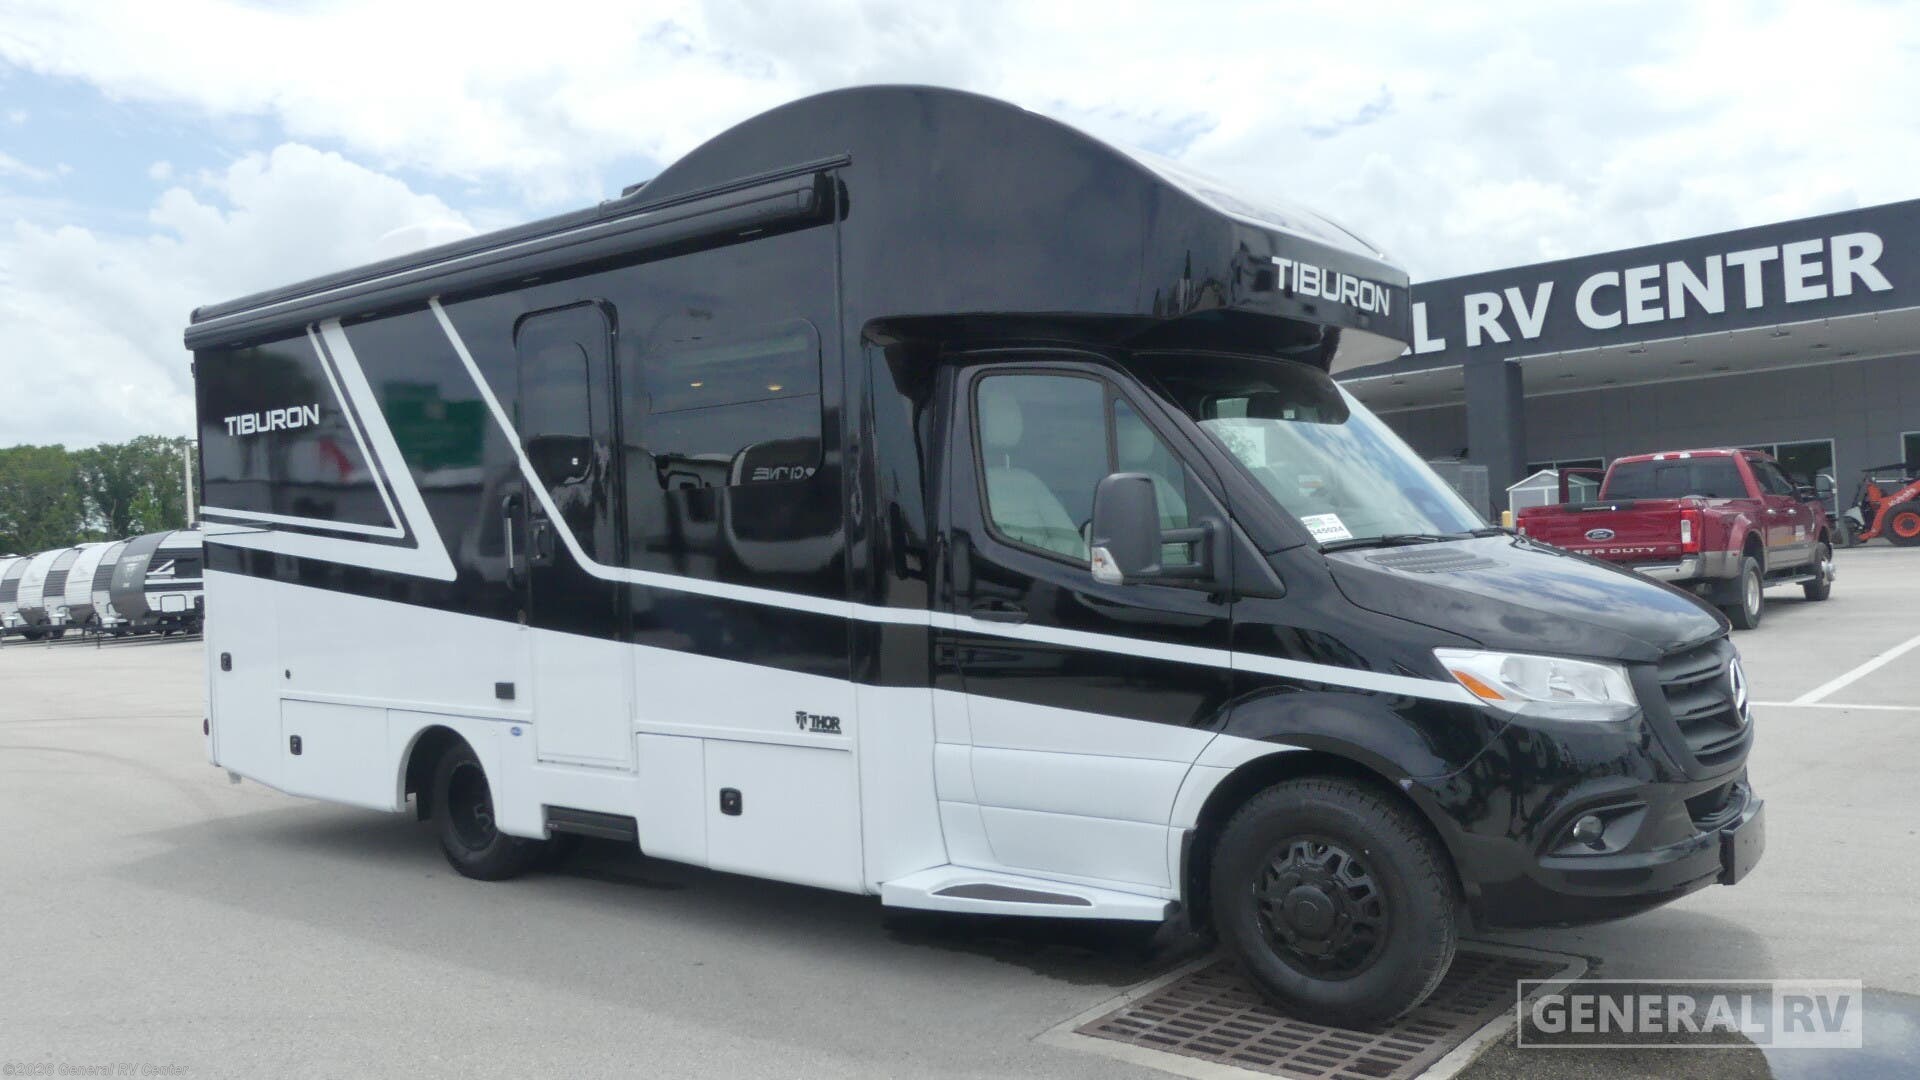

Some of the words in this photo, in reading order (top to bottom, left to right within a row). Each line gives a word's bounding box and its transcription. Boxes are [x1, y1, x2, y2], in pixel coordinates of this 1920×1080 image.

[1271, 256, 1391, 317] TIBURON
[1464, 281, 1555, 348] RV
[1575, 231, 1895, 330] CENTER
[224, 403, 320, 437] TIBURON
[808, 714, 841, 730] THOR
